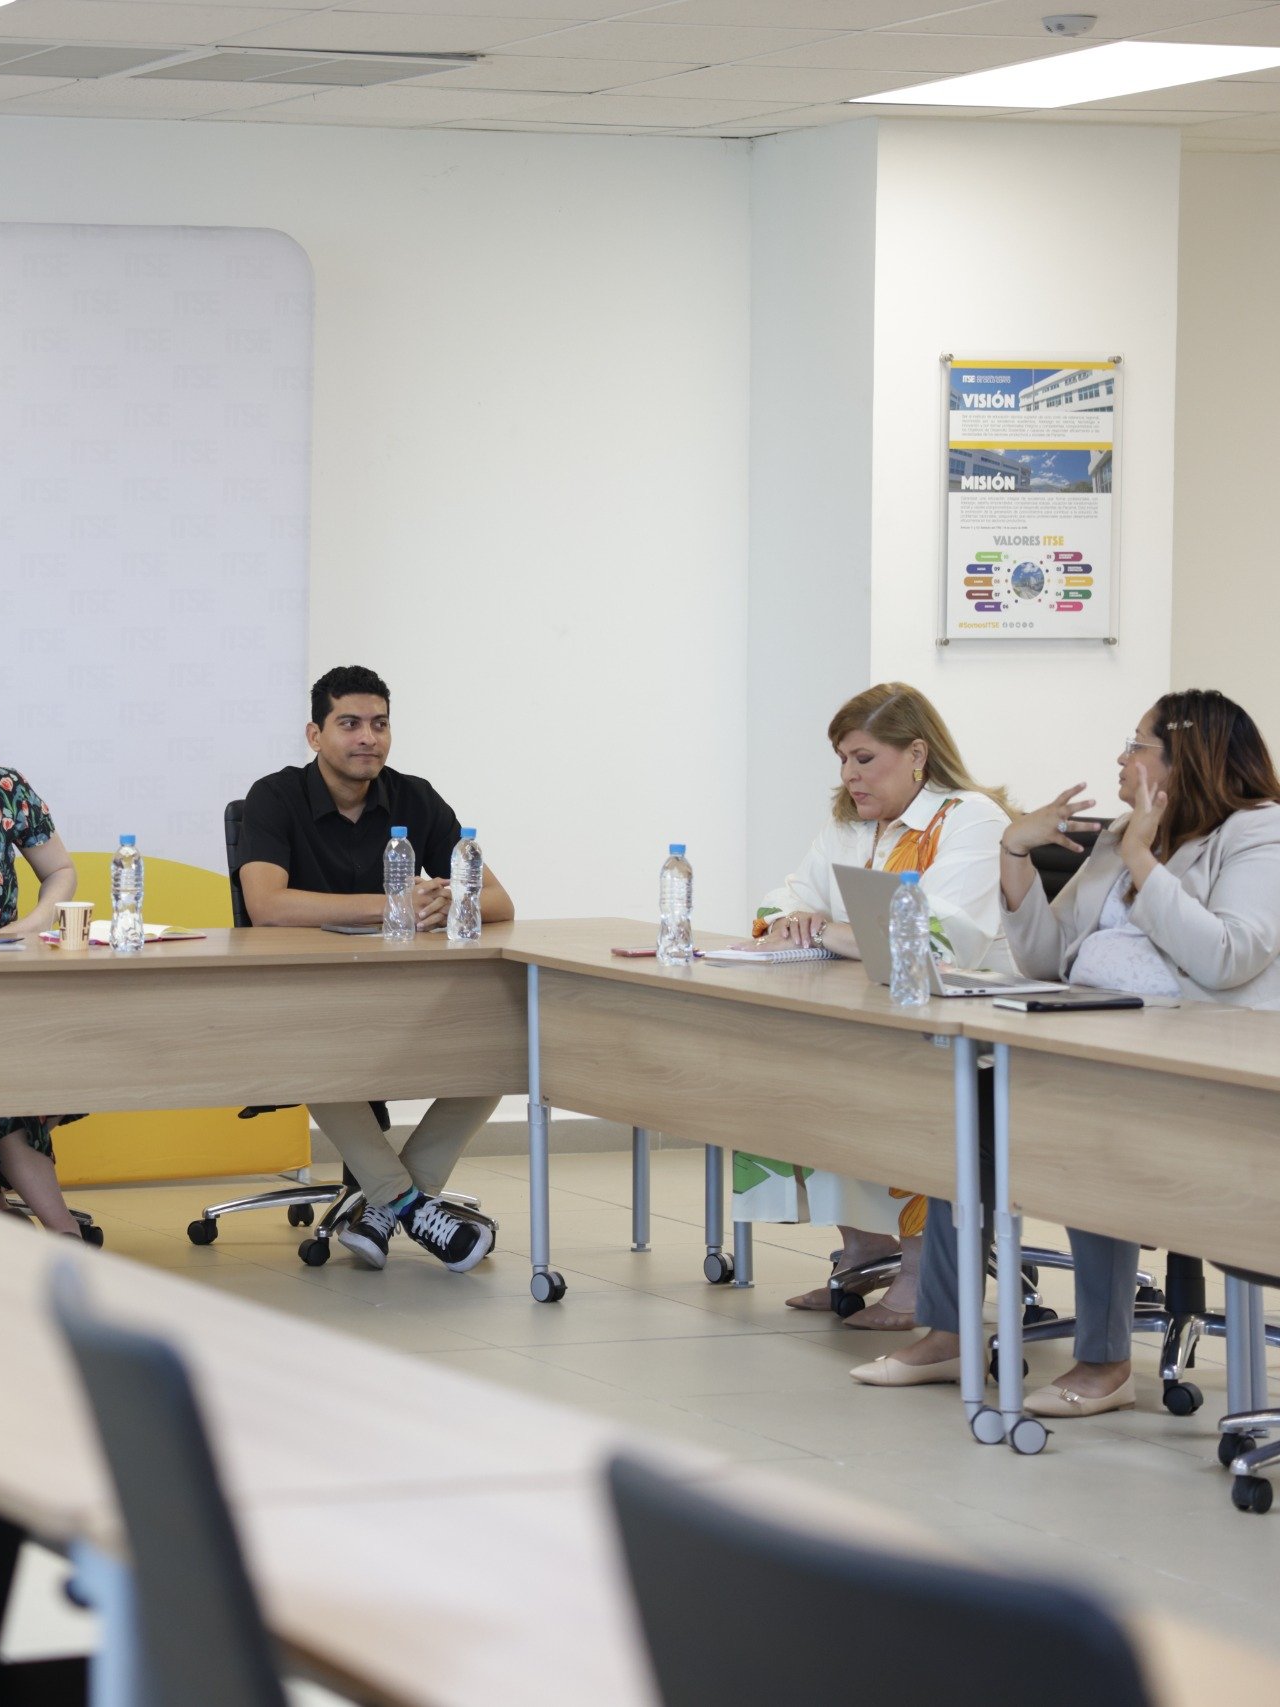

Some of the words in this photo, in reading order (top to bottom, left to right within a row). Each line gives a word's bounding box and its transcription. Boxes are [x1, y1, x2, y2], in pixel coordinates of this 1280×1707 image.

[962, 390, 1015, 409] VISIÓN
[961, 472, 1015, 490] MISIÓN
[993, 536, 1040, 546] VALORES
[1043, 536, 1064, 546] ITSE
